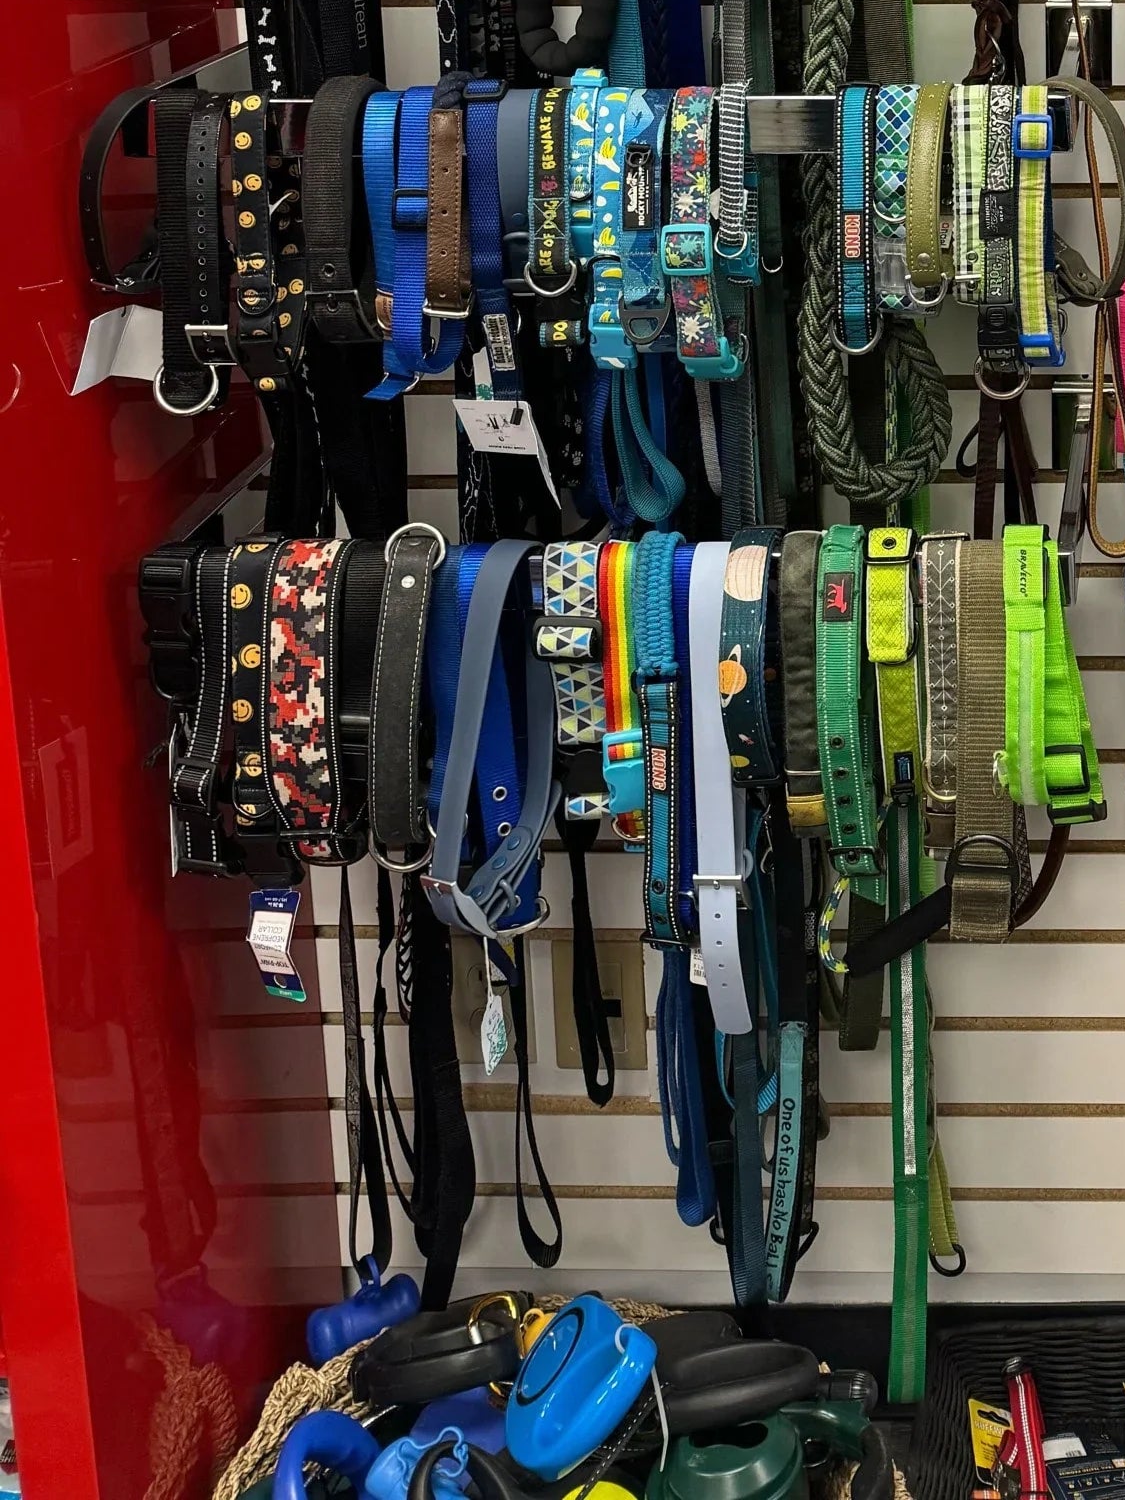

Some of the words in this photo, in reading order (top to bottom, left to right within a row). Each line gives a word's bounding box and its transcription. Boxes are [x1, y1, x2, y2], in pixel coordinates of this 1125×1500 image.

[544, 87, 563, 98] DO
[542, 100, 556, 113] OF
[538, 116, 556, 170] BEWARE
[637, 156, 646, 199] MOUNT
[542, 200, 559, 229] DOG
[638, 200, 646, 226] ROCKY
[542, 233, 554, 248] OF
[844, 214, 862, 258] KONG
[538, 250, 557, 273] ARE
[988, 254, 1006, 289] ROGZ
[552, 320, 568, 340] DO
[651, 748, 666, 791] KONG
[258, 925, 283, 934] COLLAR
[781, 1098, 796, 1131] One
[780, 1134, 794, 1155] of
[778, 1156, 790, 1176] us
[775, 1180, 792, 1208] has
[772, 1208, 789, 1231] No
